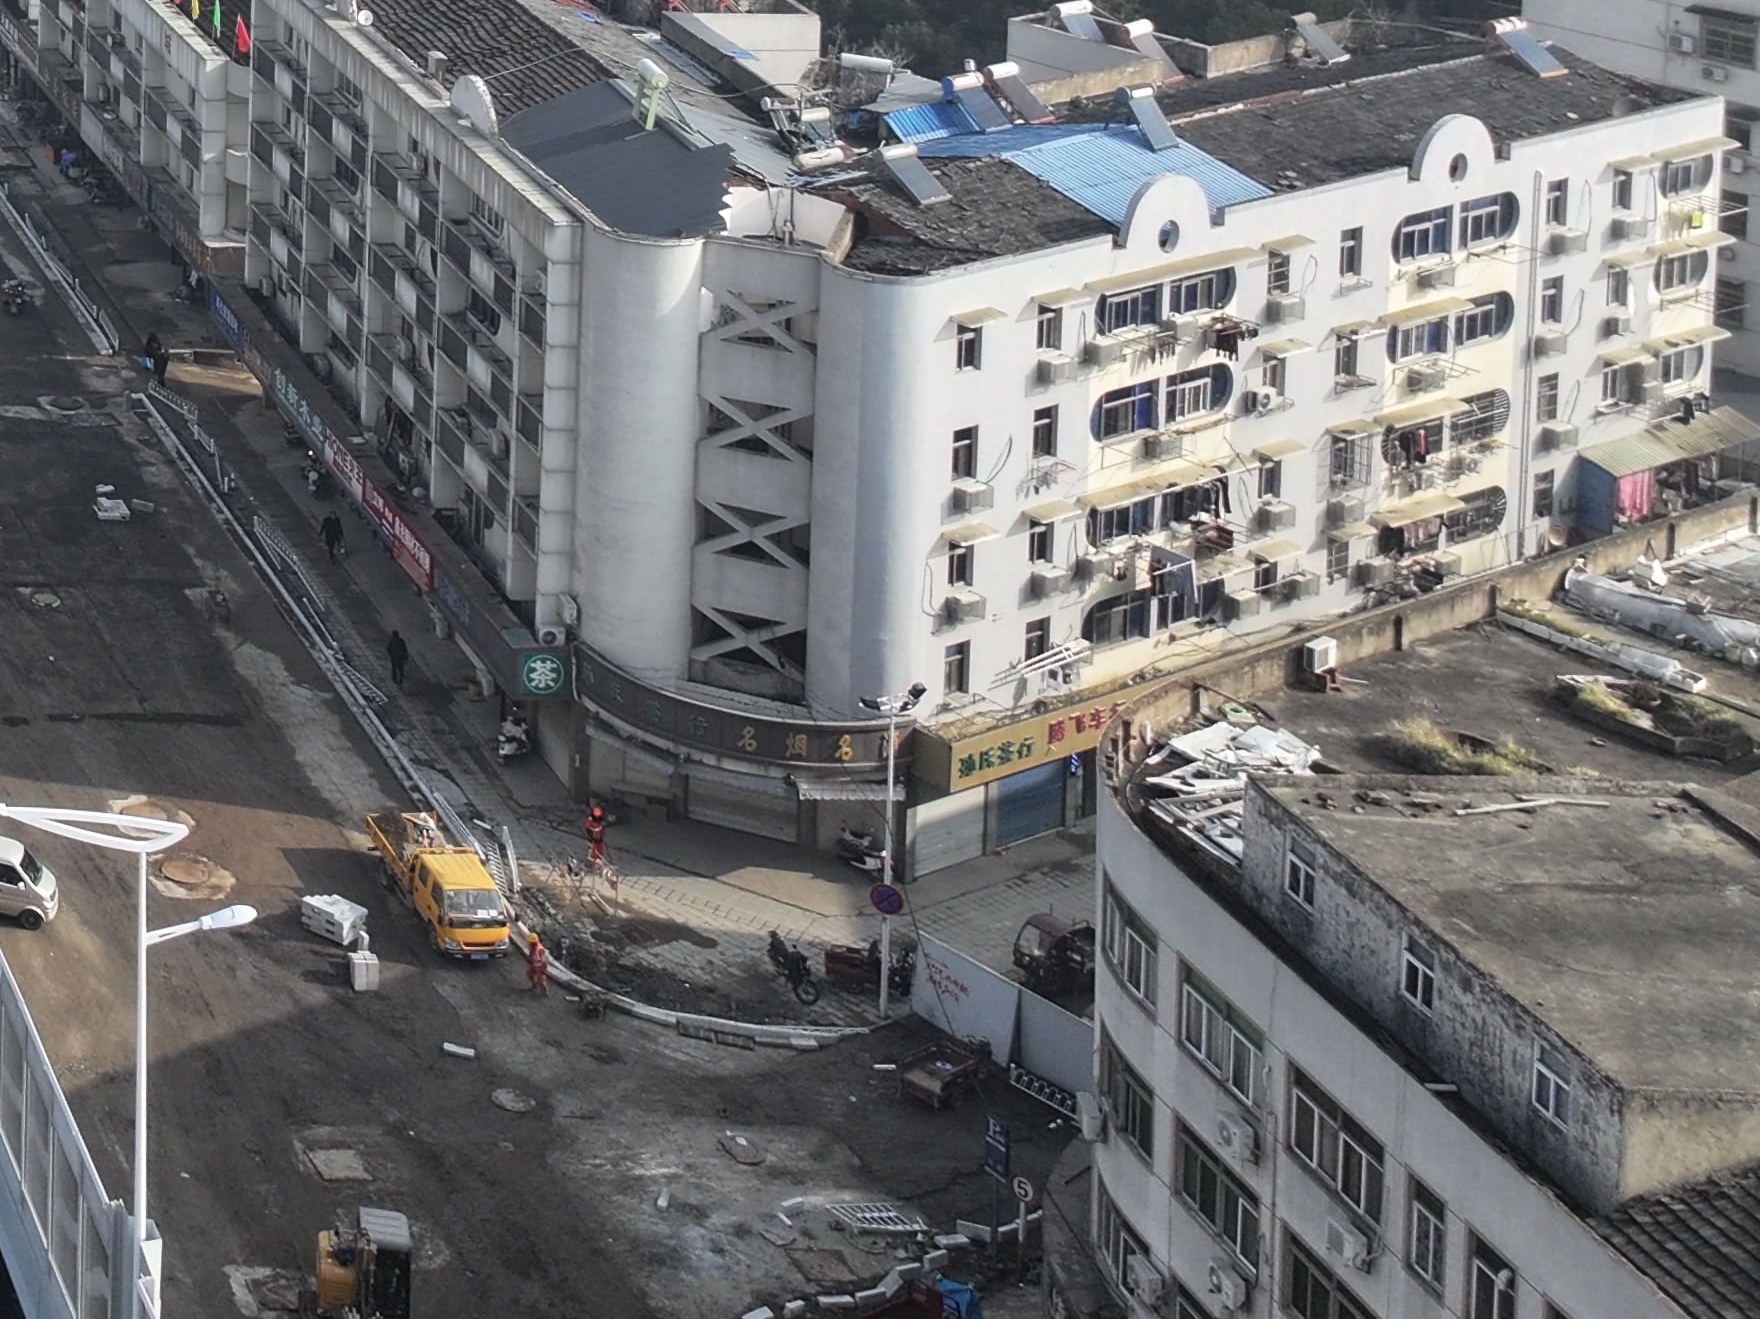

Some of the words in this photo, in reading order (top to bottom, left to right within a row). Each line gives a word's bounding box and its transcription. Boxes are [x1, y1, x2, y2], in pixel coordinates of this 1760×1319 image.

[528, 659, 558, 689] 茶
[987, 1116, 1001, 1138] P
[1016, 1180, 1028, 1199] 5
